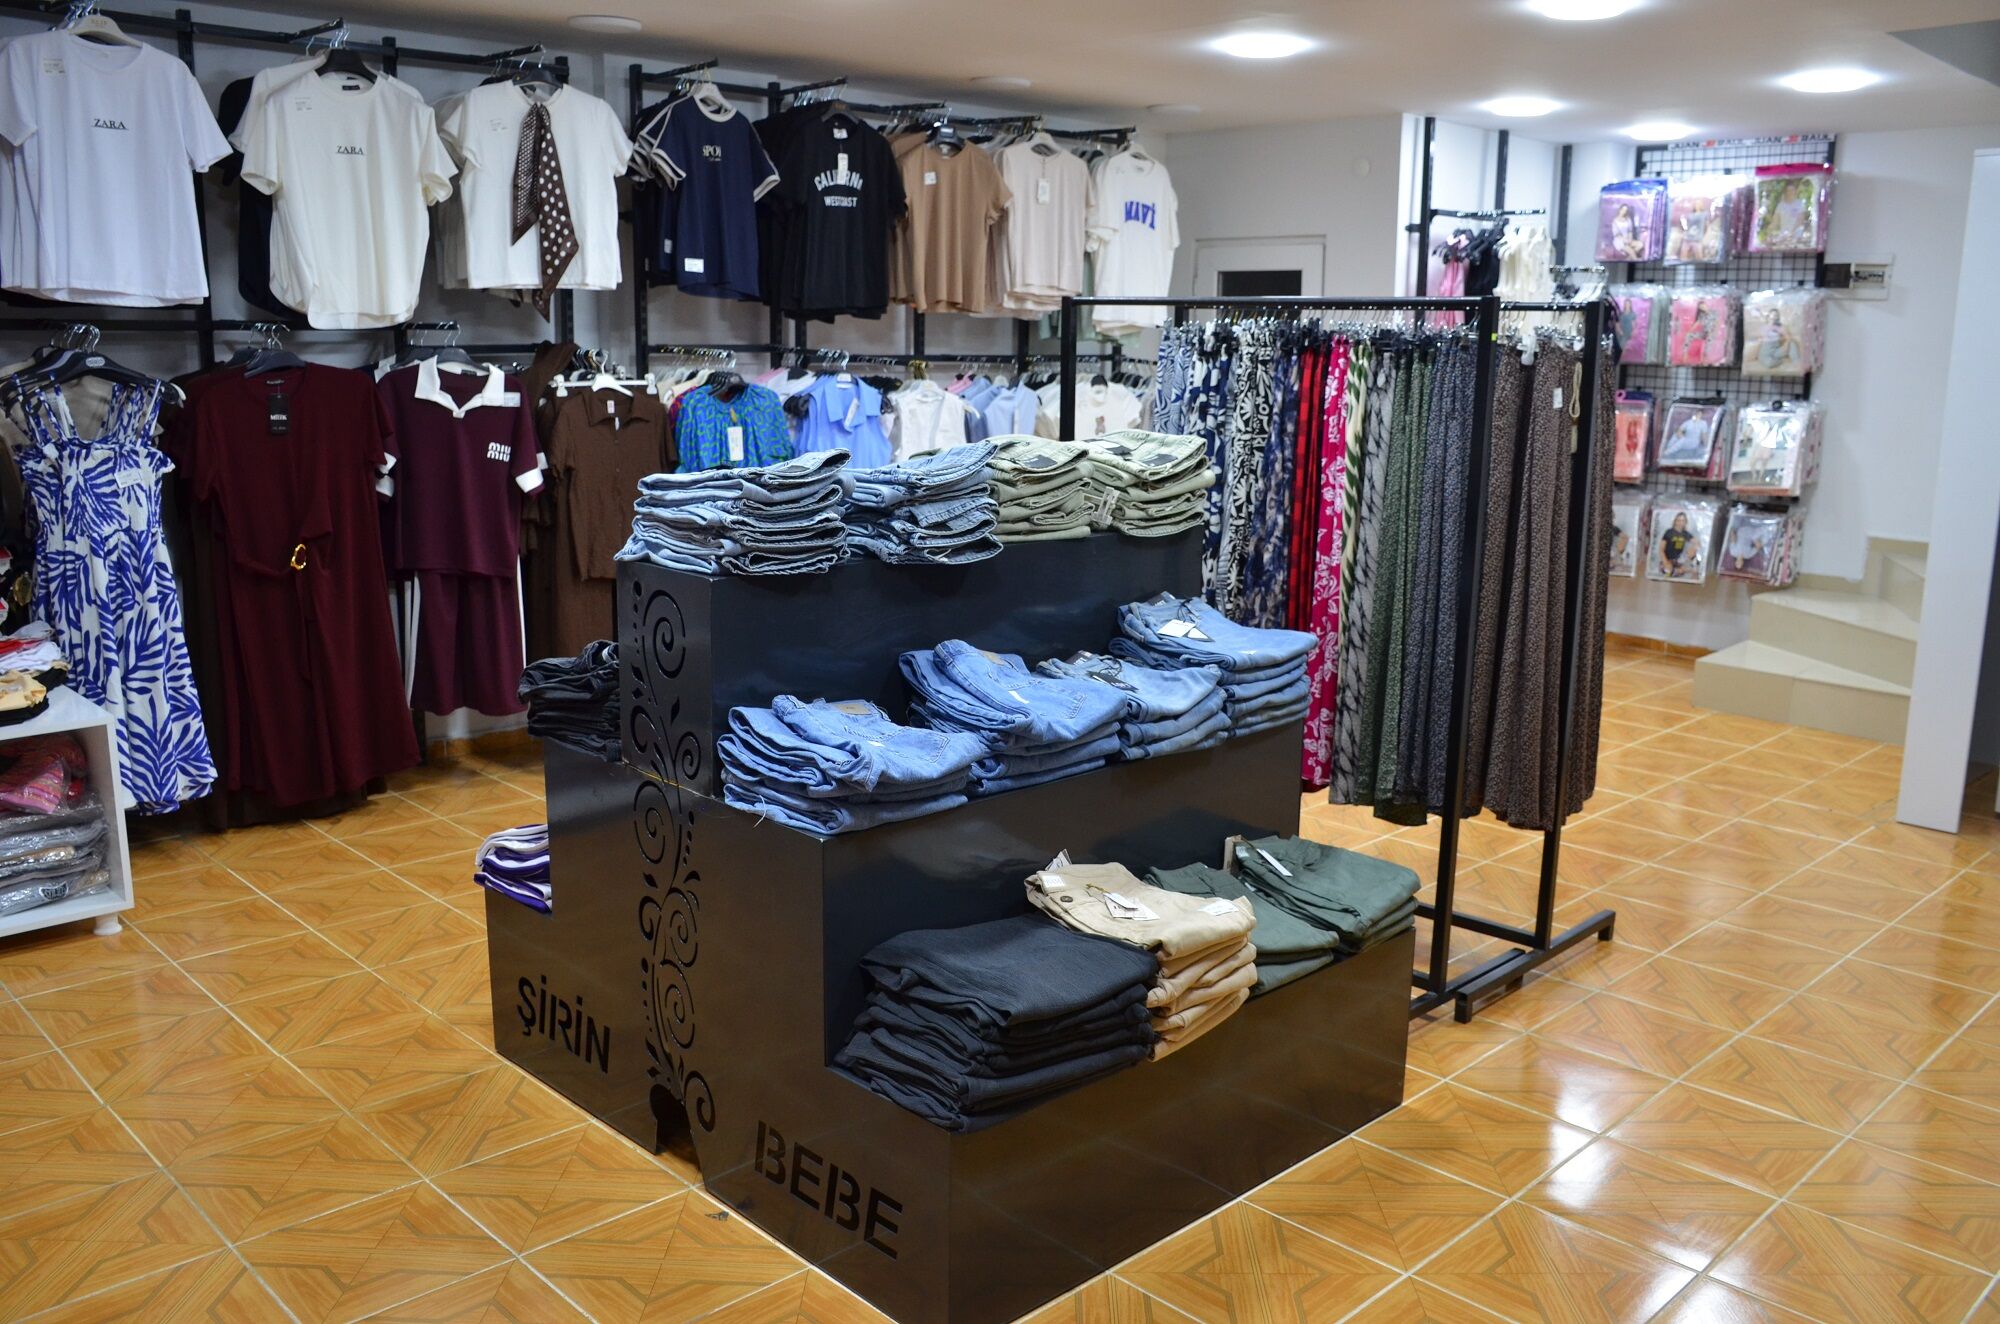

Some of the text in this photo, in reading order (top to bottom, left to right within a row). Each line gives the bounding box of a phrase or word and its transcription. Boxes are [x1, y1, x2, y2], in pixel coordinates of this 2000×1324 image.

[93, 118, 128, 131] ZARA
[336, 145, 365, 156] ZARA
[516, 974, 612, 1075] ŞİRİN
[754, 1119, 905, 1260] BEBE
